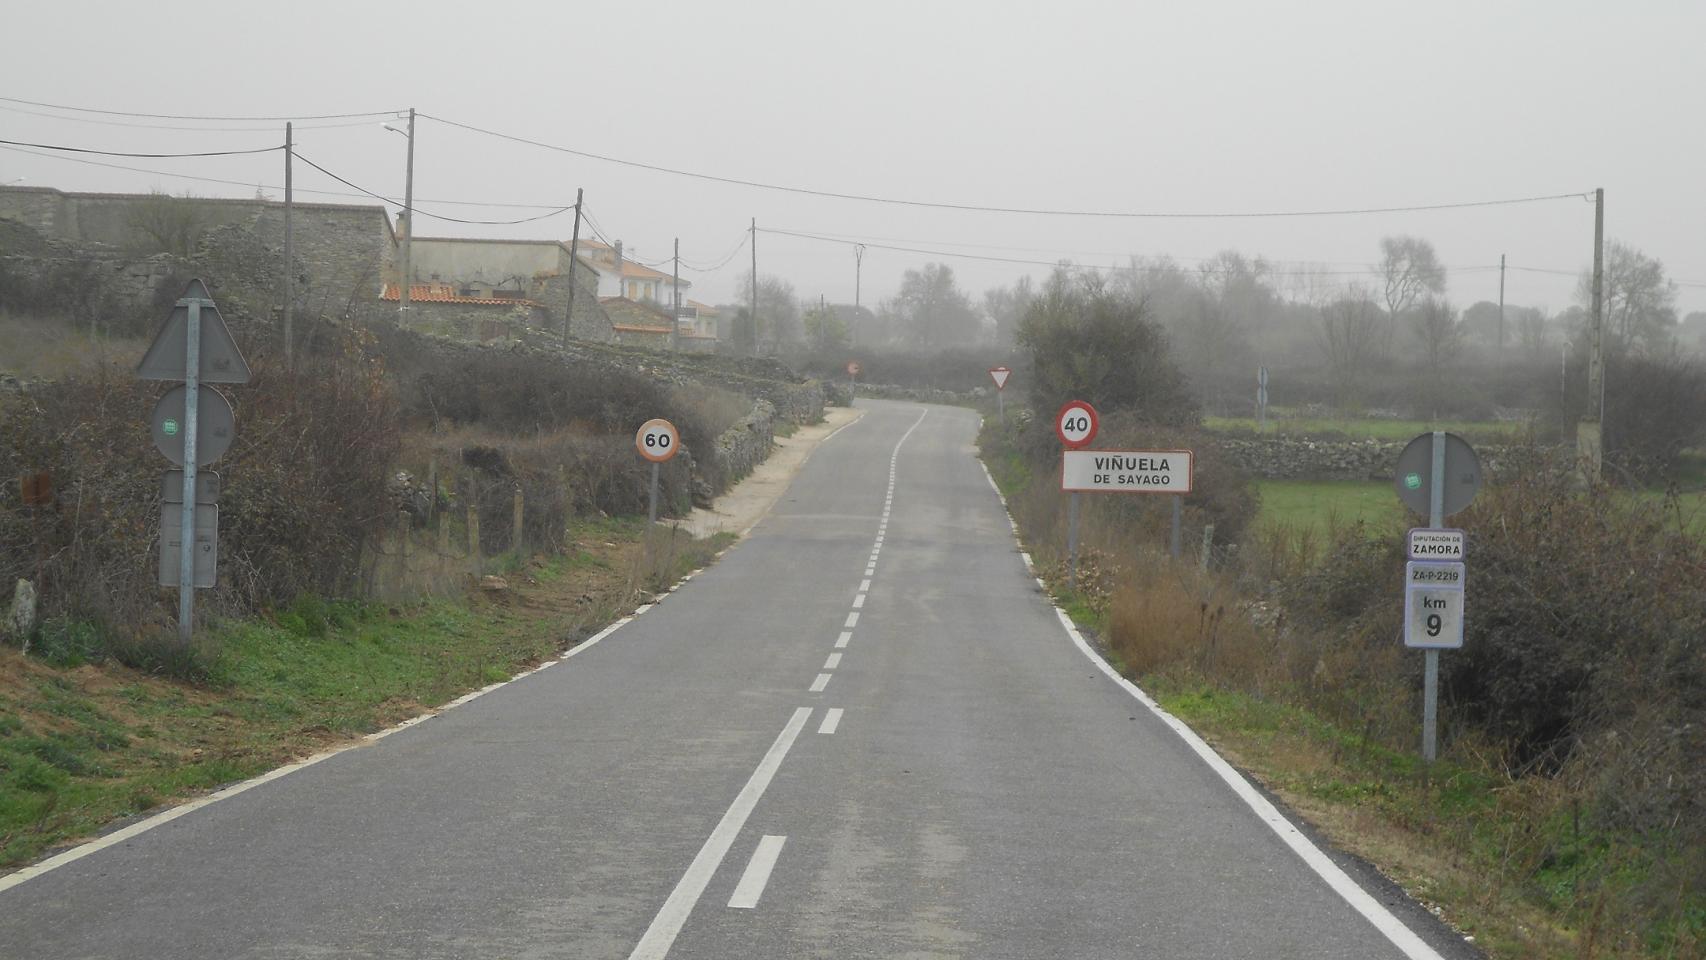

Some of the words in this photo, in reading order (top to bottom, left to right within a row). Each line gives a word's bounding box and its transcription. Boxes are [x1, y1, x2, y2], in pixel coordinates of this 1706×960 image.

[1064, 417, 1088, 432] 40
[645, 433, 670, 448] 60
[1094, 454, 1170, 471] VIÑUELA
[1093, 474, 1111, 484] DE
[1118, 474, 1171, 485] SAYAGO
[1413, 544, 1461, 554] ZAMORA
[1423, 596, 1446, 608] km
[1427, 614, 1442, 637] 9
